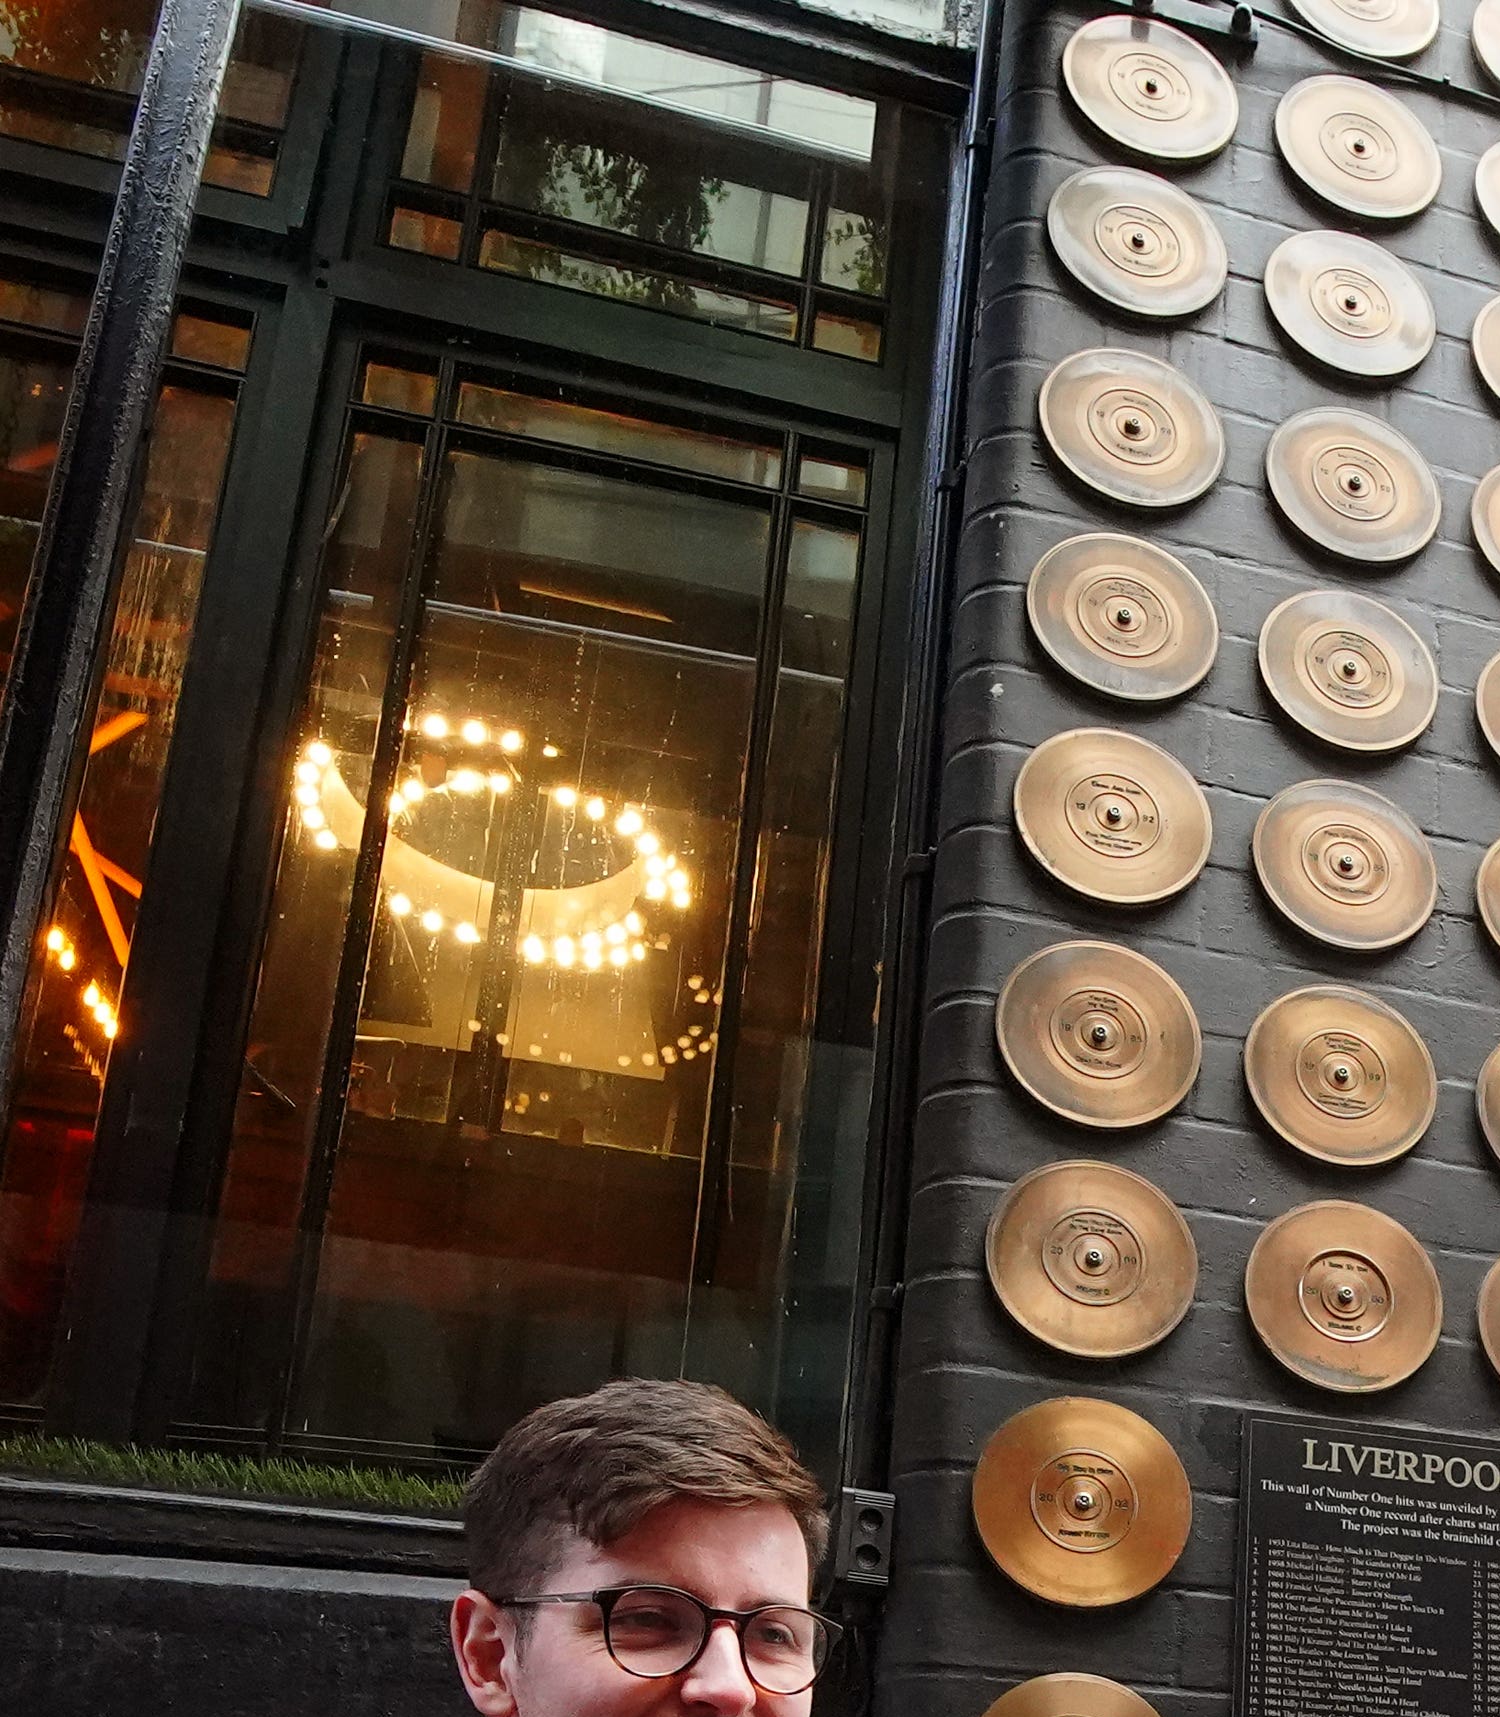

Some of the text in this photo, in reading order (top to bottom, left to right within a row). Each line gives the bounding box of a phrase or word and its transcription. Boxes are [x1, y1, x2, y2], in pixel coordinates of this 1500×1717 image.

[1262, 1480, 1283, 1493] This
[1287, 1483, 1308, 1496] wall
[1312, 1486, 1322, 1497] of
[1327, 1488, 1368, 1503] Number
[1371, 1493, 1392, 1505] One
[1396, 1495, 1414, 1508] hits
[1417, 1502, 1436, 1510] was
[1440, 1500, 1482, 1516] unveiled
[1485, 1506, 1497, 1520] by
[1315, 1501, 1357, 1516] Number
[1360, 1506, 1381, 1519] One
[1384, 1509, 1416, 1522] record
[1419, 1512, 1442, 1525] after
[1445, 1515, 1475, 1529] charts
[1342, 1519, 1360, 1532] The
[1363, 1522, 1398, 1538] project
[1402, 1529, 1421, 1538] was
[1424, 1528, 1440, 1540] the
[1442, 1530, 1493, 1545] brainchild
